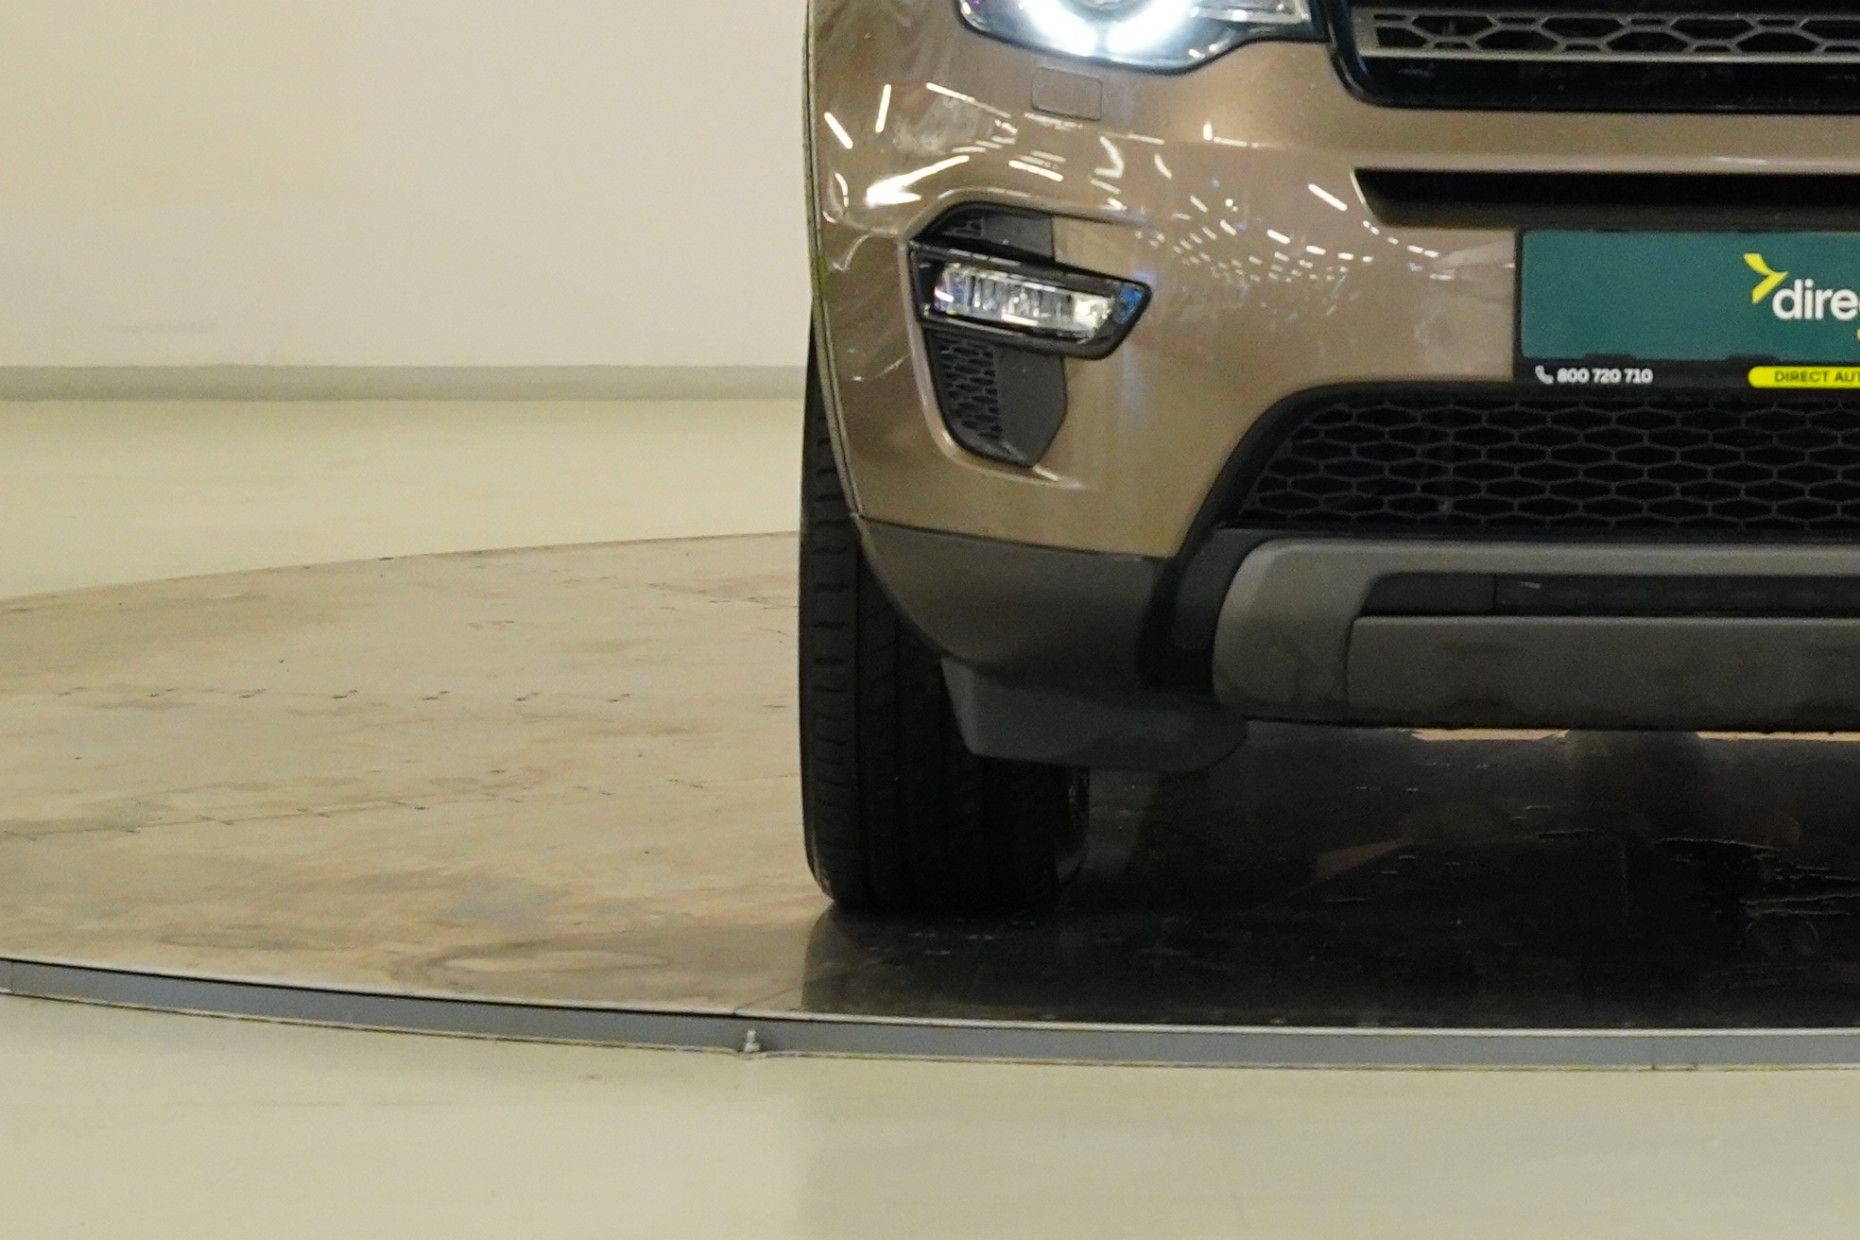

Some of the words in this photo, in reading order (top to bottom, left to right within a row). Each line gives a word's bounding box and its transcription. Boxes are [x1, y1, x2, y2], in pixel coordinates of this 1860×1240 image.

[1557, 367, 1590, 384] 800
[1591, 367, 1622, 384] 720
[1623, 367, 1654, 384] 710
[1774, 370, 1829, 383] DIRECT
